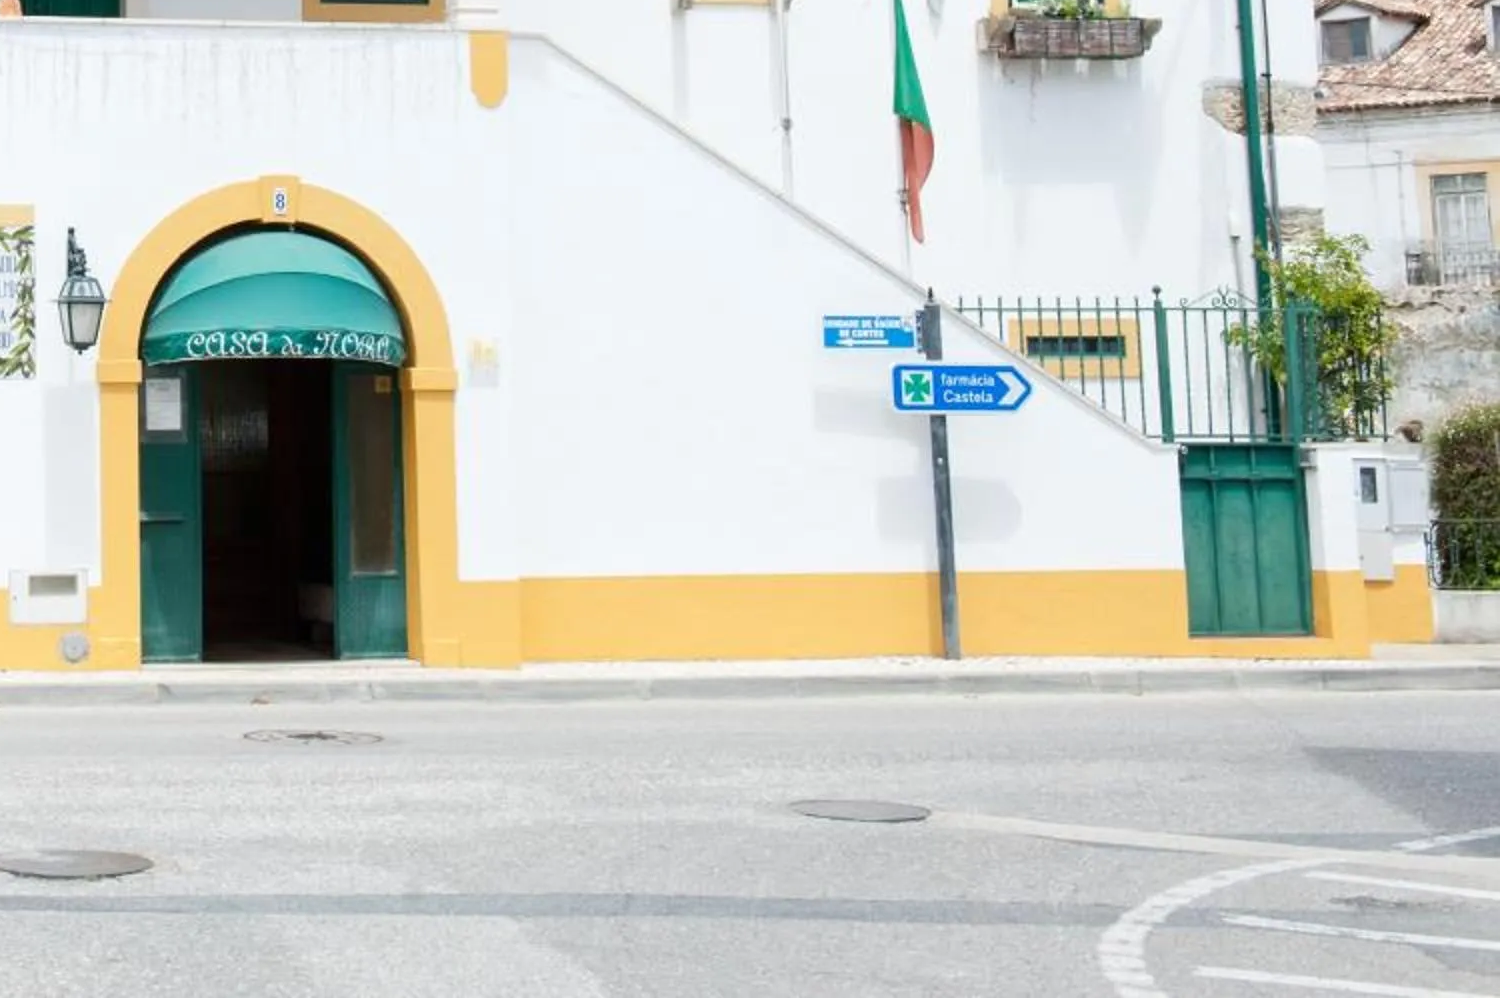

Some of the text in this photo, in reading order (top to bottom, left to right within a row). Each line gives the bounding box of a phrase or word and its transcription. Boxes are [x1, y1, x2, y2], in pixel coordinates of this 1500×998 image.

[274, 192, 286, 211] 8
[940, 373, 995, 387] farmácia
[943, 389, 994, 404] Castela
